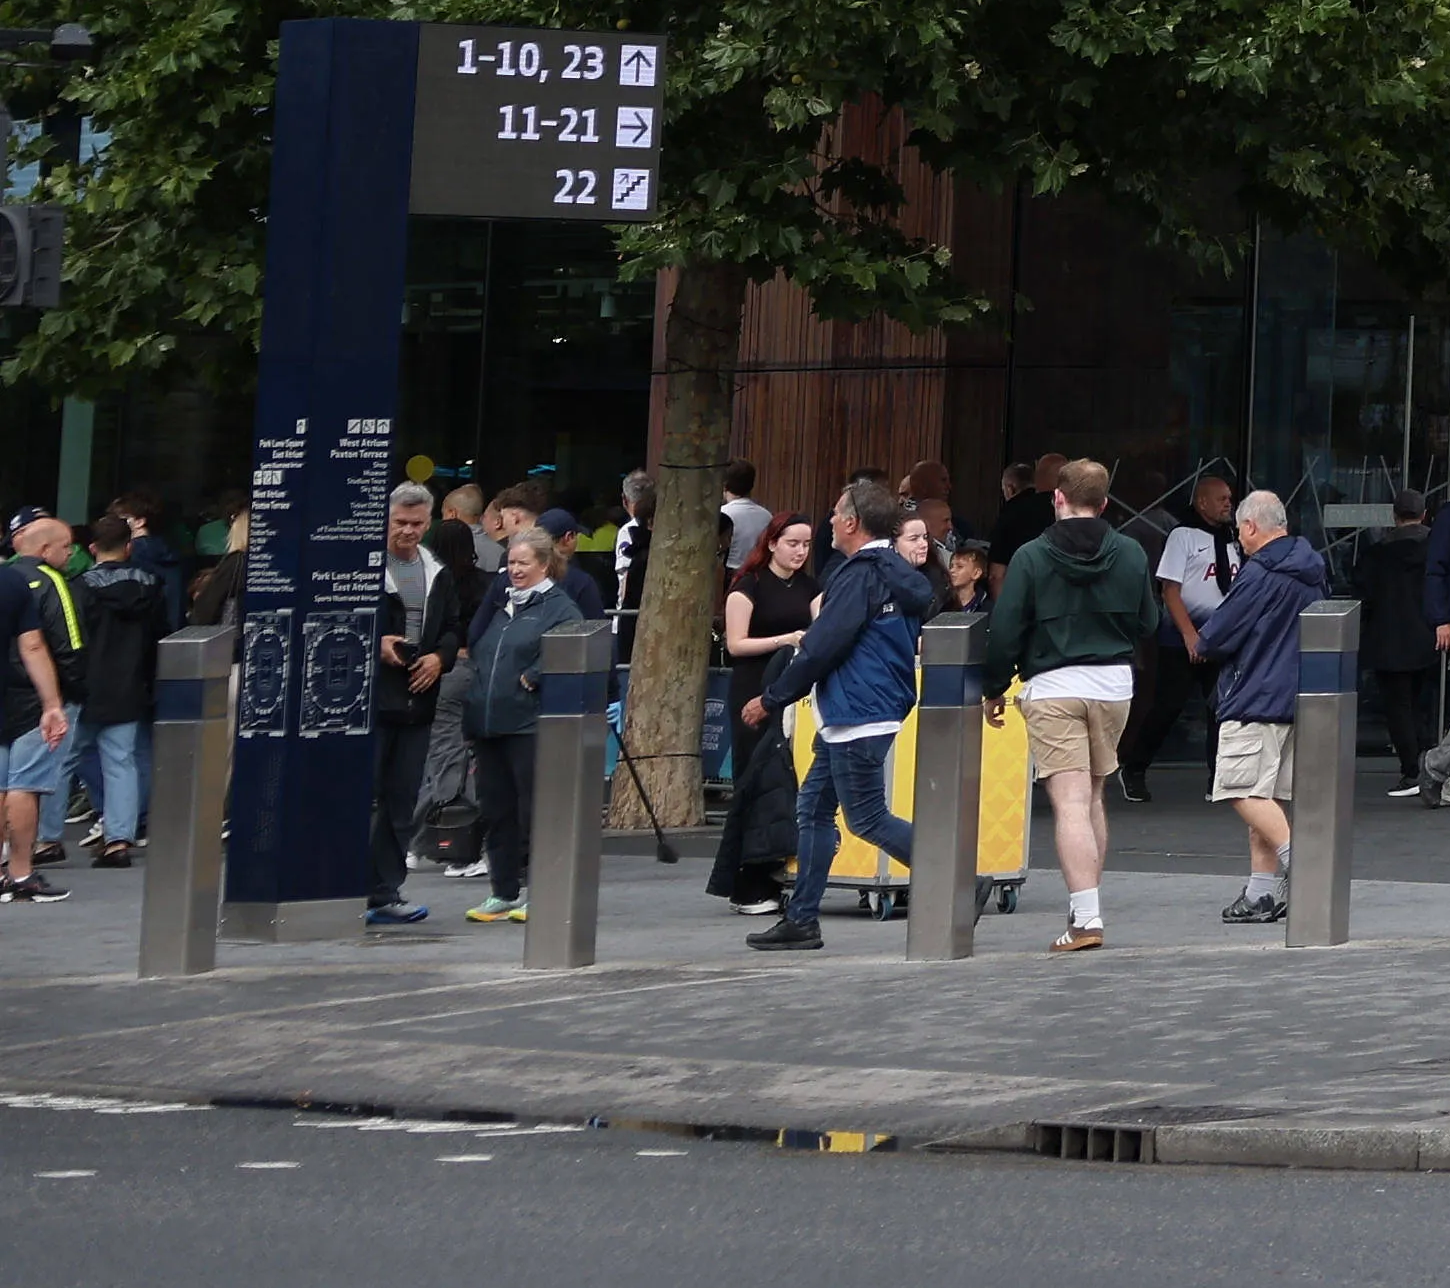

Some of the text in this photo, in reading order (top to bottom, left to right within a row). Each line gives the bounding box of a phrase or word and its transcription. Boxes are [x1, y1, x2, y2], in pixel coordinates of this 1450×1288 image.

[561, 45, 604, 80] 23
[498, 105, 600, 143] 11-21
[553, 169, 597, 204] 22
[339, 438, 360, 447] West
[330, 449, 388, 459] Paxton Terrace
[312, 571, 380, 581] Park Lane Square
[332, 583, 351, 591] East
